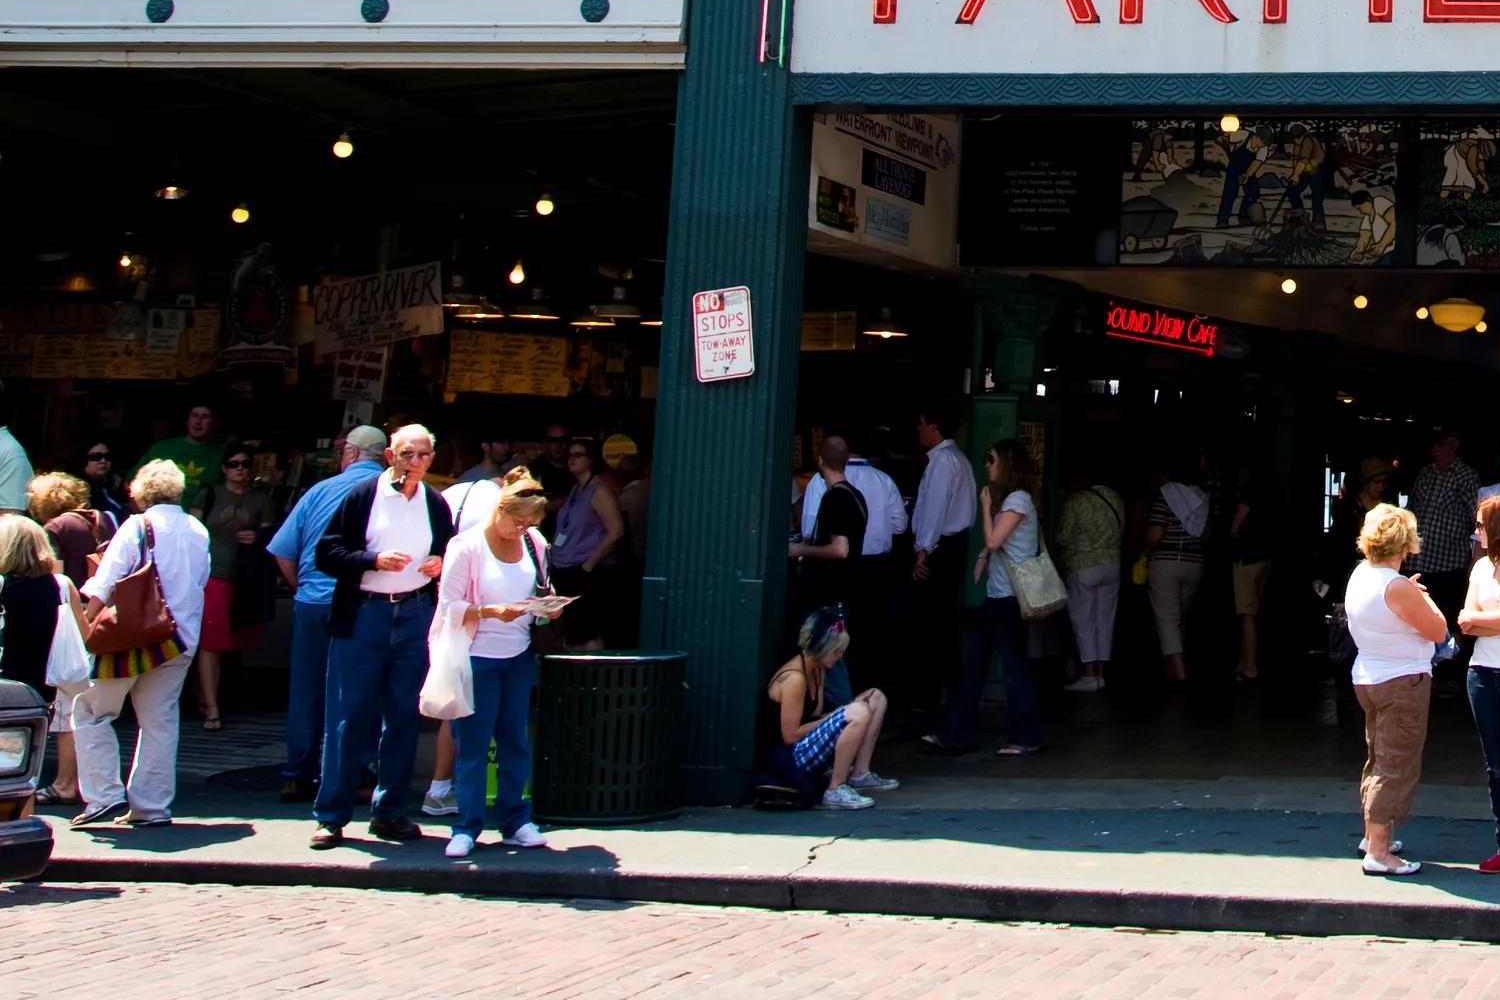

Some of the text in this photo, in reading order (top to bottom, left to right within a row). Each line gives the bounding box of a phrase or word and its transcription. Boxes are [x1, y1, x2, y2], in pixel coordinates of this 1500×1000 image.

[895, 130, 934, 161] VIEWPOINT
[381, 265, 440, 312] RIVER
[699, 294, 721, 312] NO
[701, 312, 744, 332] STOPS
[1152, 311, 1185, 339] VIEW
[712, 349, 737, 362] ZONE
